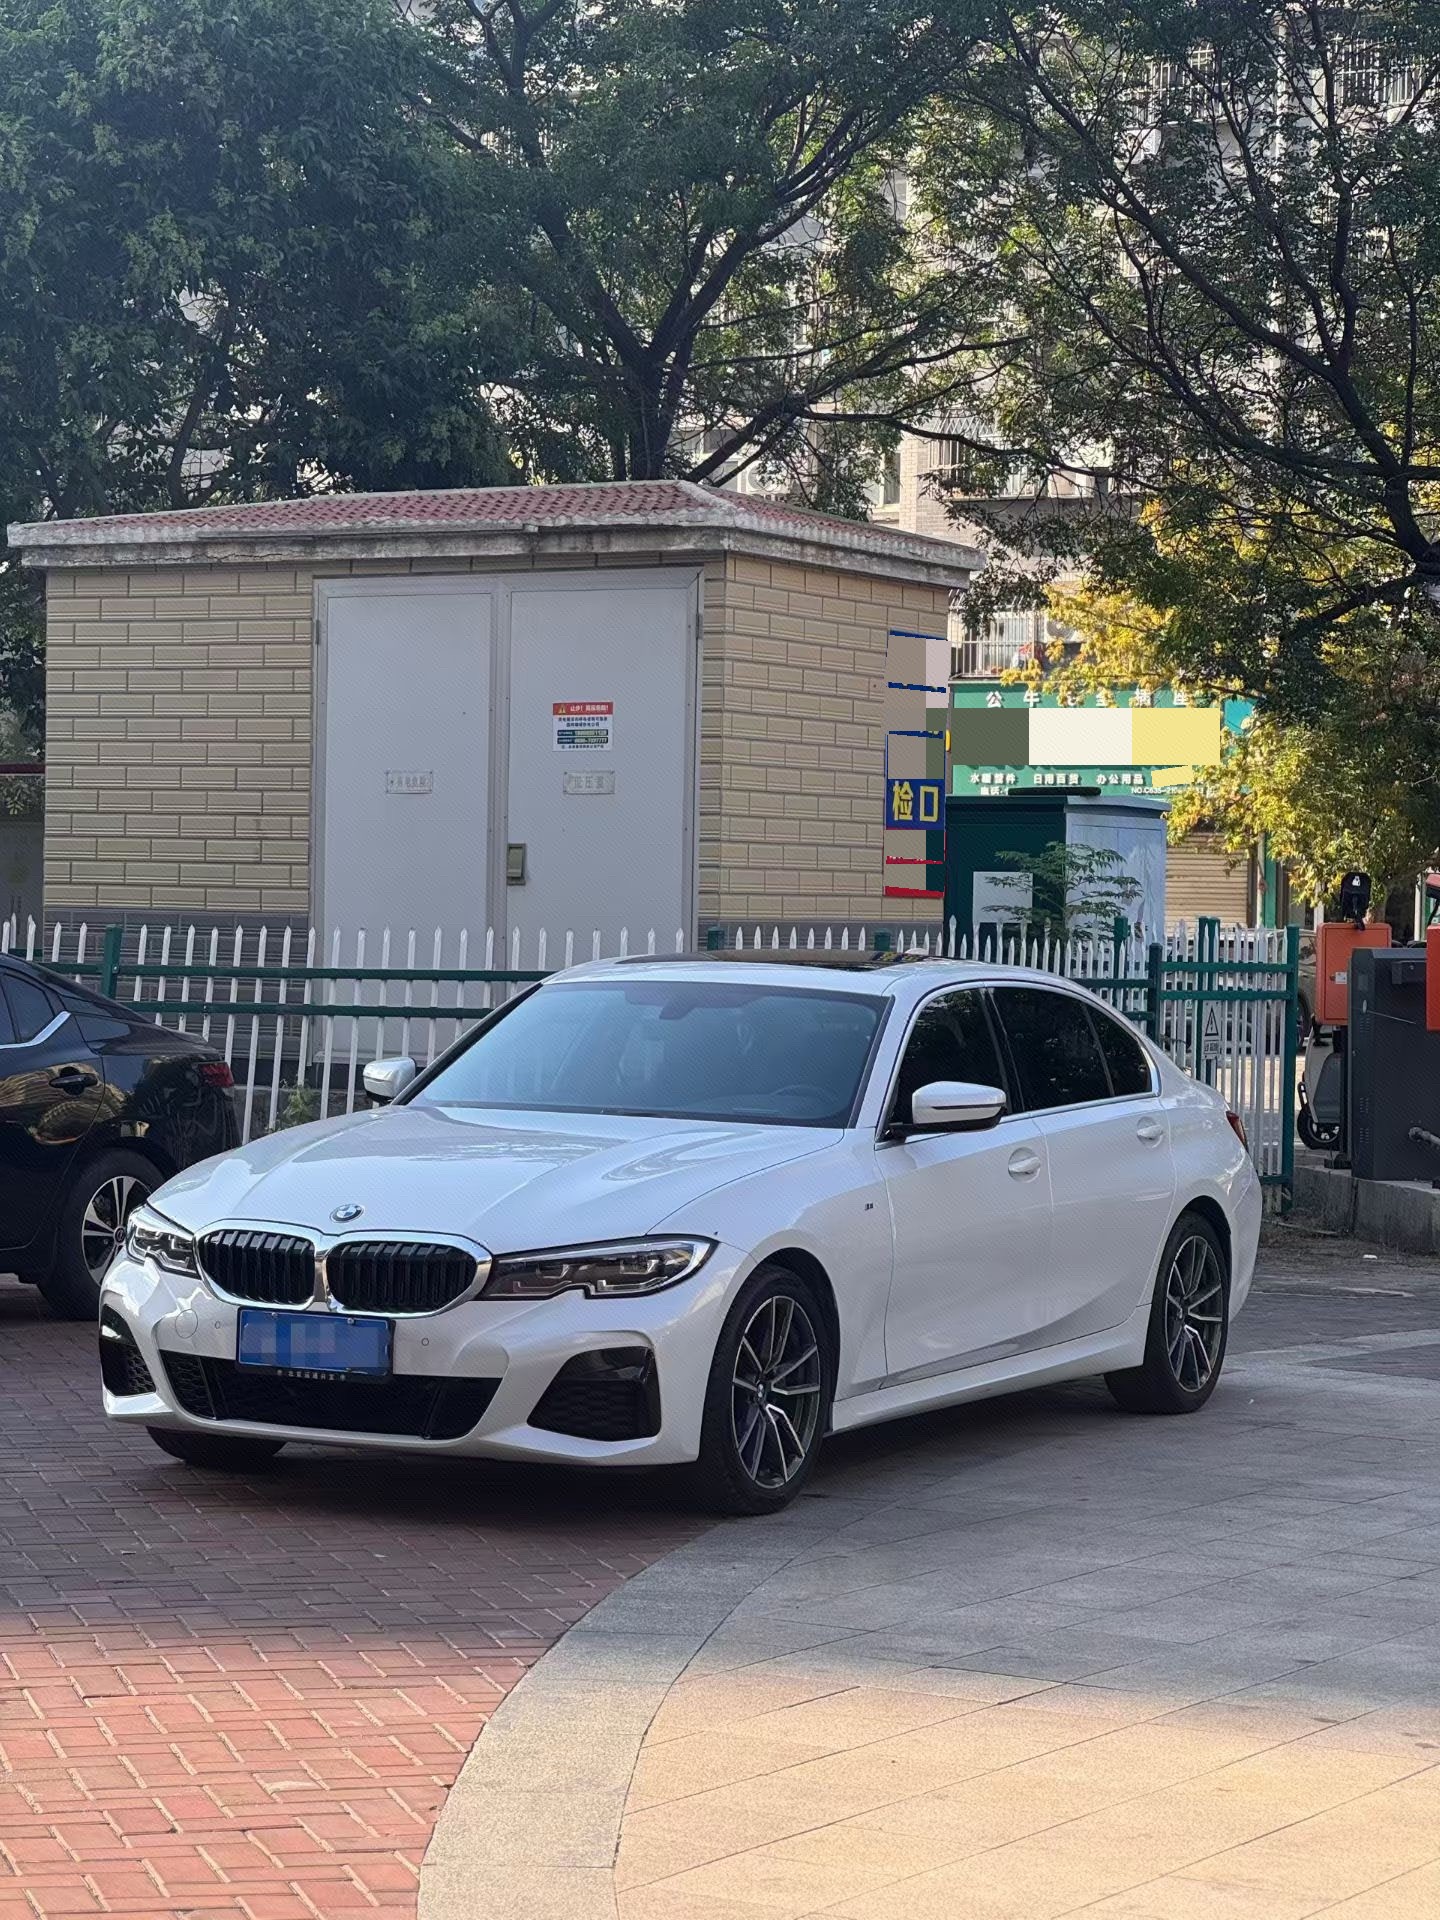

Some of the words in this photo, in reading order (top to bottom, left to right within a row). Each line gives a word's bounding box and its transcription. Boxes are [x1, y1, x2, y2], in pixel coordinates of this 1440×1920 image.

[1033, 773, 1079, 785] 日用百货
[1096, 773, 1144, 785] 办公用品
